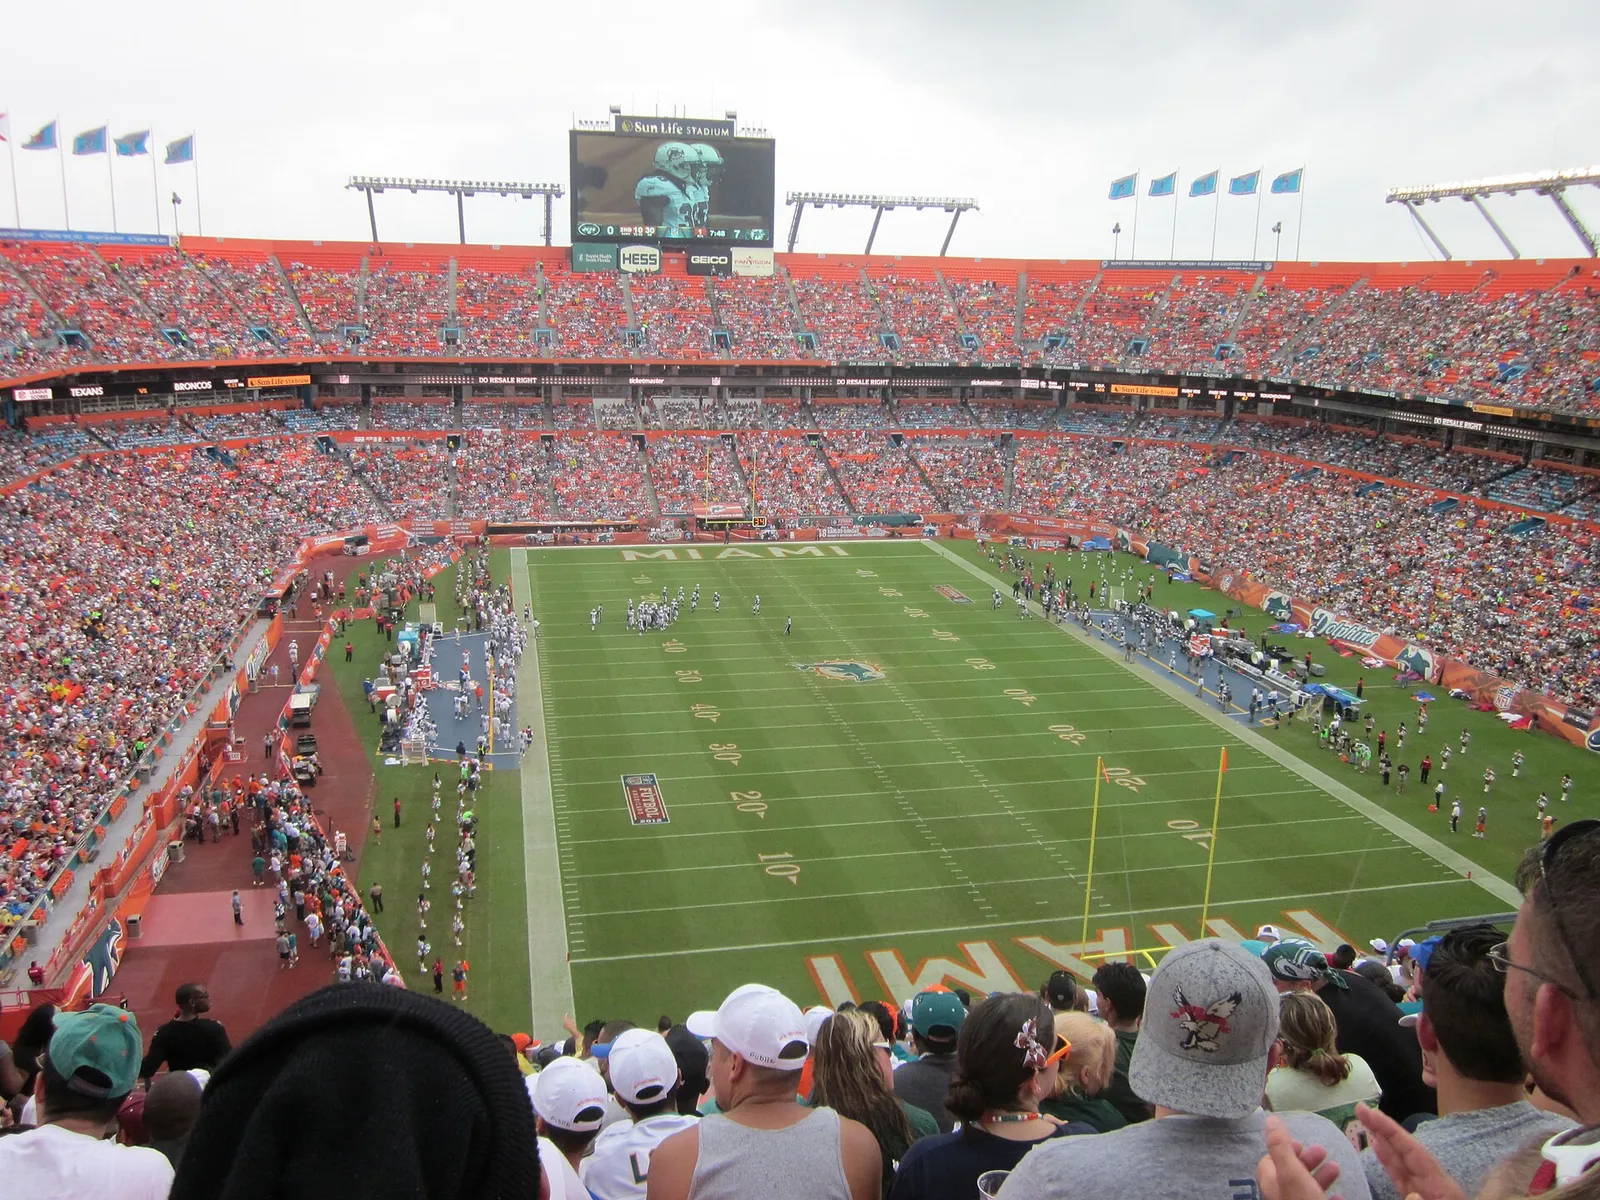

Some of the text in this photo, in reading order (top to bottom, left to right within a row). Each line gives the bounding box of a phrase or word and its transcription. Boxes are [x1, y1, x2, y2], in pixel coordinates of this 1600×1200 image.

[634, 121, 729, 136] Sun Life STADIUM
[606, 226, 614, 235] 0
[734, 230, 740, 238] 7
[622, 254, 658, 266] HESS
[691, 256, 728, 264] GEICO
[70, 387, 104, 398] TEXANS
[174, 381, 212, 391] BRONCOS
[1442, 418, 1463, 427] RESALE
[1464, 421, 1483, 430] RIGHT
[621, 546, 849, 561] MIAMI
[904, 608, 929, 618] 30
[1312, 607, 1380, 646] Dolphins
[934, 632, 960, 642] 40
[662, 641, 687, 654] 40
[966, 658, 996, 670] 50
[675, 669, 702, 683] 50
[1004, 689, 1037, 702] 40
[1498, 696, 1510, 708] NFL
[690, 703, 720, 718] 40
[1048, 724, 1086, 740] 30
[709, 743, 742, 760] 30
[1102, 768, 1146, 786] 20
[639, 788, 659, 818] FÚTBOL
[730, 790, 768, 812] 20
[1167, 820, 1214, 841] 10
[758, 852, 800, 876] 10
